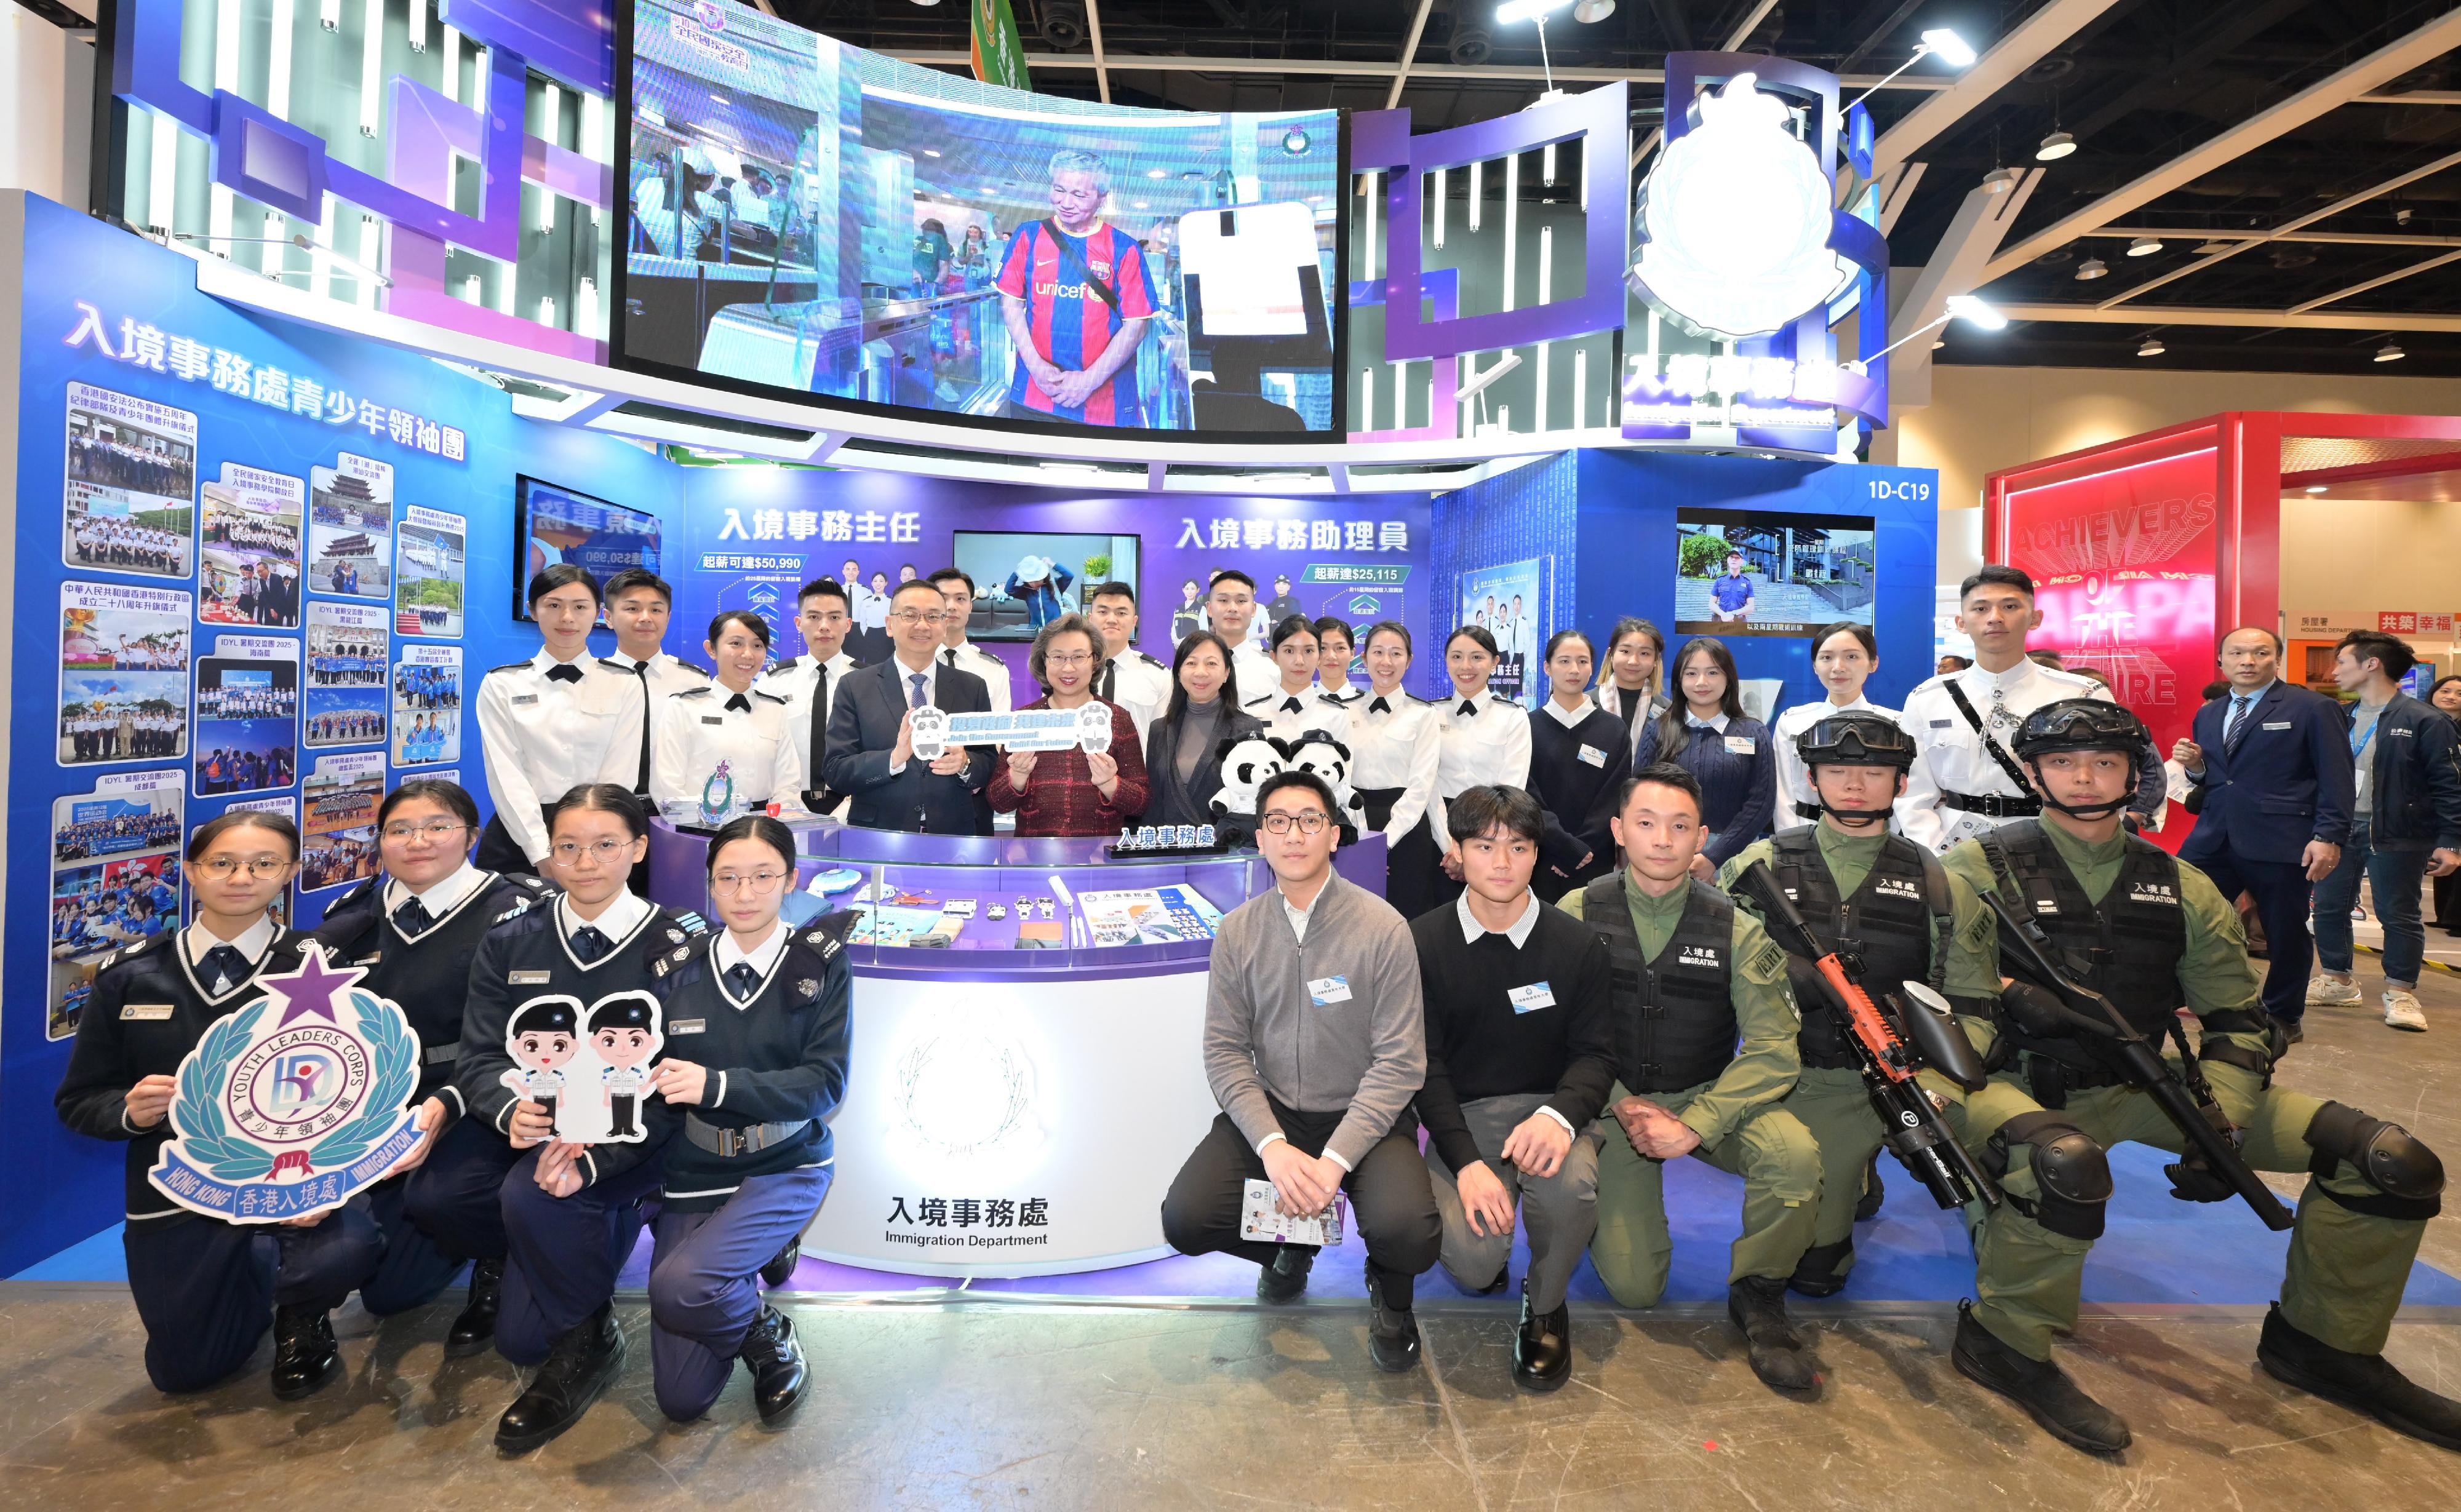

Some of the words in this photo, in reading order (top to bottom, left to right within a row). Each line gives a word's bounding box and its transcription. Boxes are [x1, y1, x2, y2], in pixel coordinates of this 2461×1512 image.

[1035, 280, 1087, 298] unicef
[65, 301, 466, 461] 入境事務處青少年領袖團
[81, 386, 186, 420] 香港國安法公布實施五周年
[233, 468, 294, 488] 全民國家安全教育日
[233, 478, 293, 497] 入境事務學院開放日
[1868, 479, 1930, 501] 1D-C19
[717, 508, 921, 544] 入境事務主任
[2012, 493, 2216, 556] ACHIEVERS
[1176, 518, 1409, 552] 入境事務助理員
[703, 555, 801, 570] 起薪可達$50,990
[1314, 567, 1397, 581] 起薪達$25,115
[65, 584, 189, 602] 中華人民共和國香港特別行政區
[79, 597, 177, 612] 成立二十八周年升旗儀式
[1747, 623, 1803, 632] 以及兩星期戰術訓練
[2302, 617, 2328, 626] 房屋署
[2070, 615, 2138, 649] THE
[135, 782, 156, 791] 成都篇
[1117, 826, 1215, 848] 入境事務處
[1875, 886, 1920, 900] IMMIGRATION
[1880, 878, 1916, 892] 入境處
[2134, 882, 2171, 896] 入境處
[2131, 893, 2177, 905] IMMIGRATION
[1971, 910, 1993, 944] ERT
[1678, 956, 1719, 968] IMMIGRATION
[1683, 946, 1715, 959] 入境處
[1758, 947, 1782, 974] ERT
[233, 1054, 265, 1103] YOUTH
[268, 1030, 343, 1052] LEADERS
[343, 1044, 365, 1087] CORPS
[236, 1097, 354, 1138] 青少年領袖團
[351, 1129, 413, 1182] IMMIGRATION
[165, 1166, 198, 1196] HONG
[196, 1184, 232, 1207] KONG
[239, 1176, 337, 1214] 香港入境處
[886, 1196, 1049, 1228] 入境事務處
[885, 1231, 964, 1248] Immigration
[969, 1233, 1048, 1249] Department
